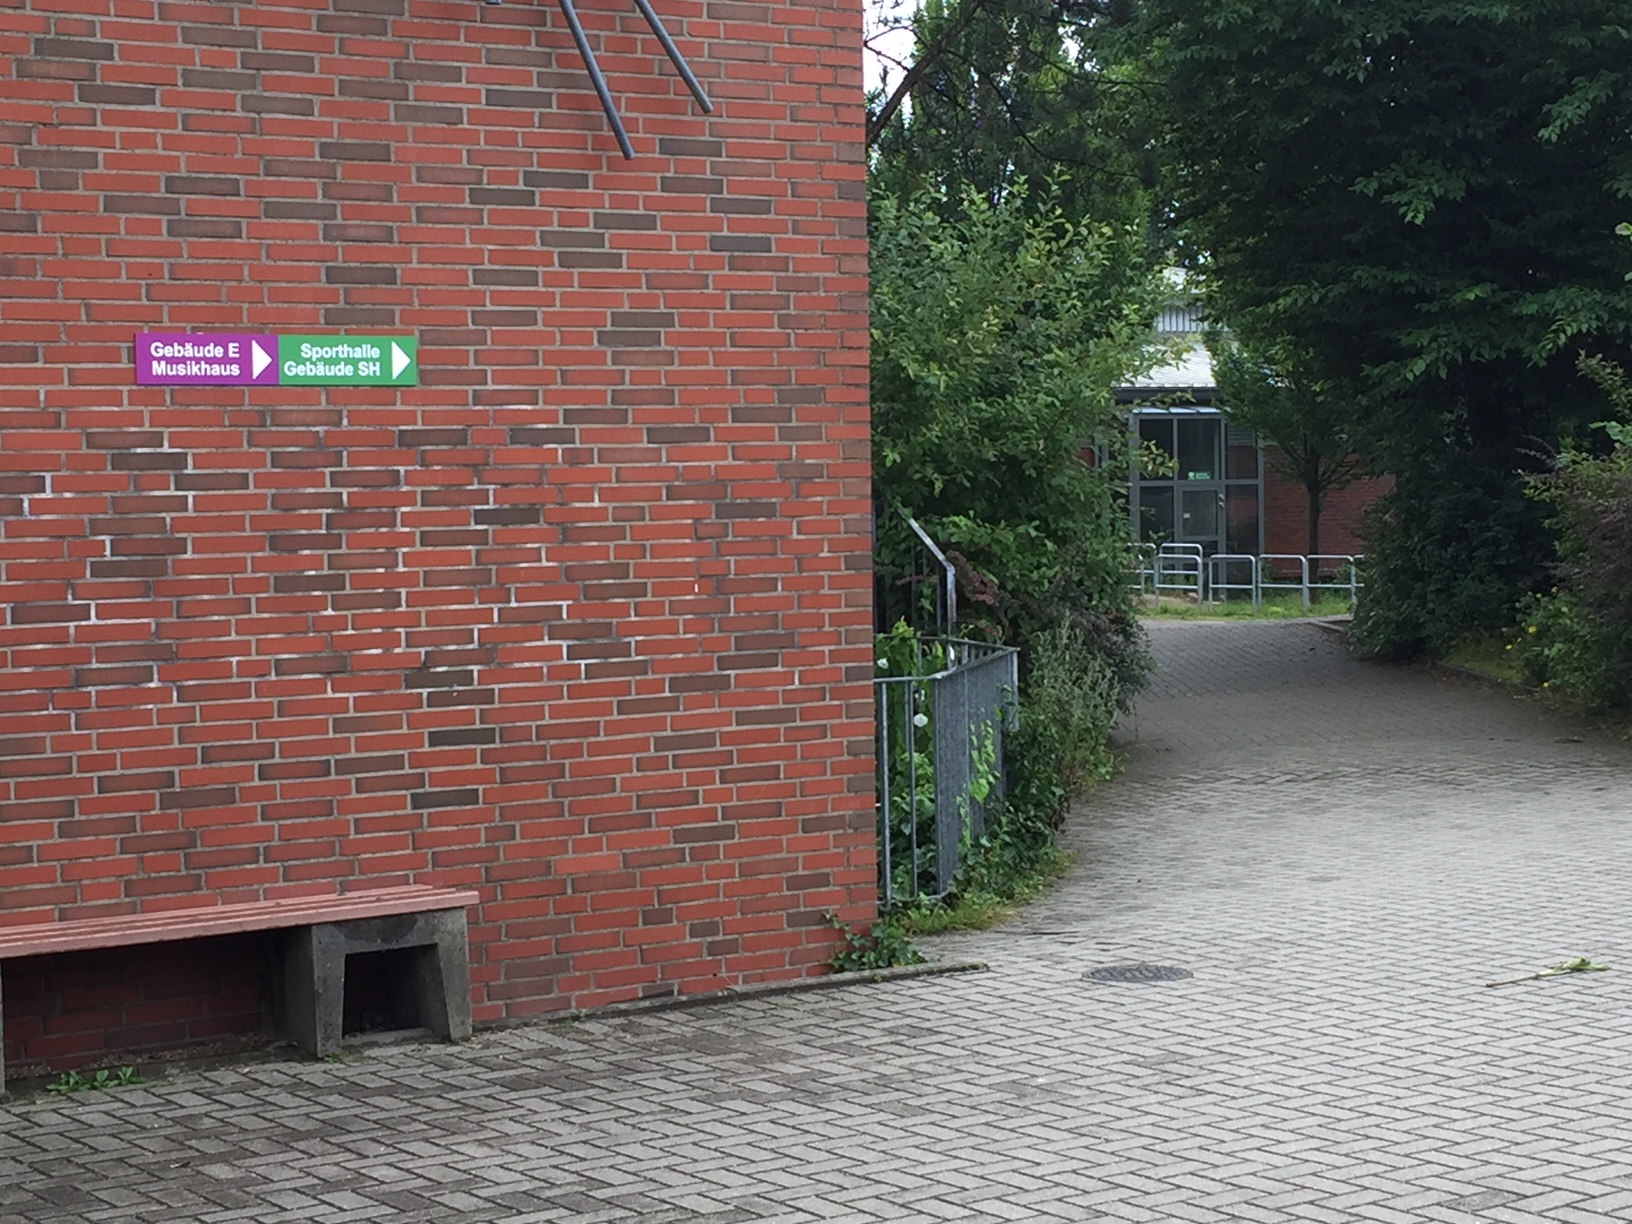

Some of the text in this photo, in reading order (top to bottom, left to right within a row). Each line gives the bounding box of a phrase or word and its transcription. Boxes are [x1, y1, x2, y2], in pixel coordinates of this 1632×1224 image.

[150, 341, 240, 358] Gebäude E
[300, 343, 380, 361] Sporthalle
[152, 360, 240, 376] Musikhaus
[284, 361, 381, 376] Gebäude SH
